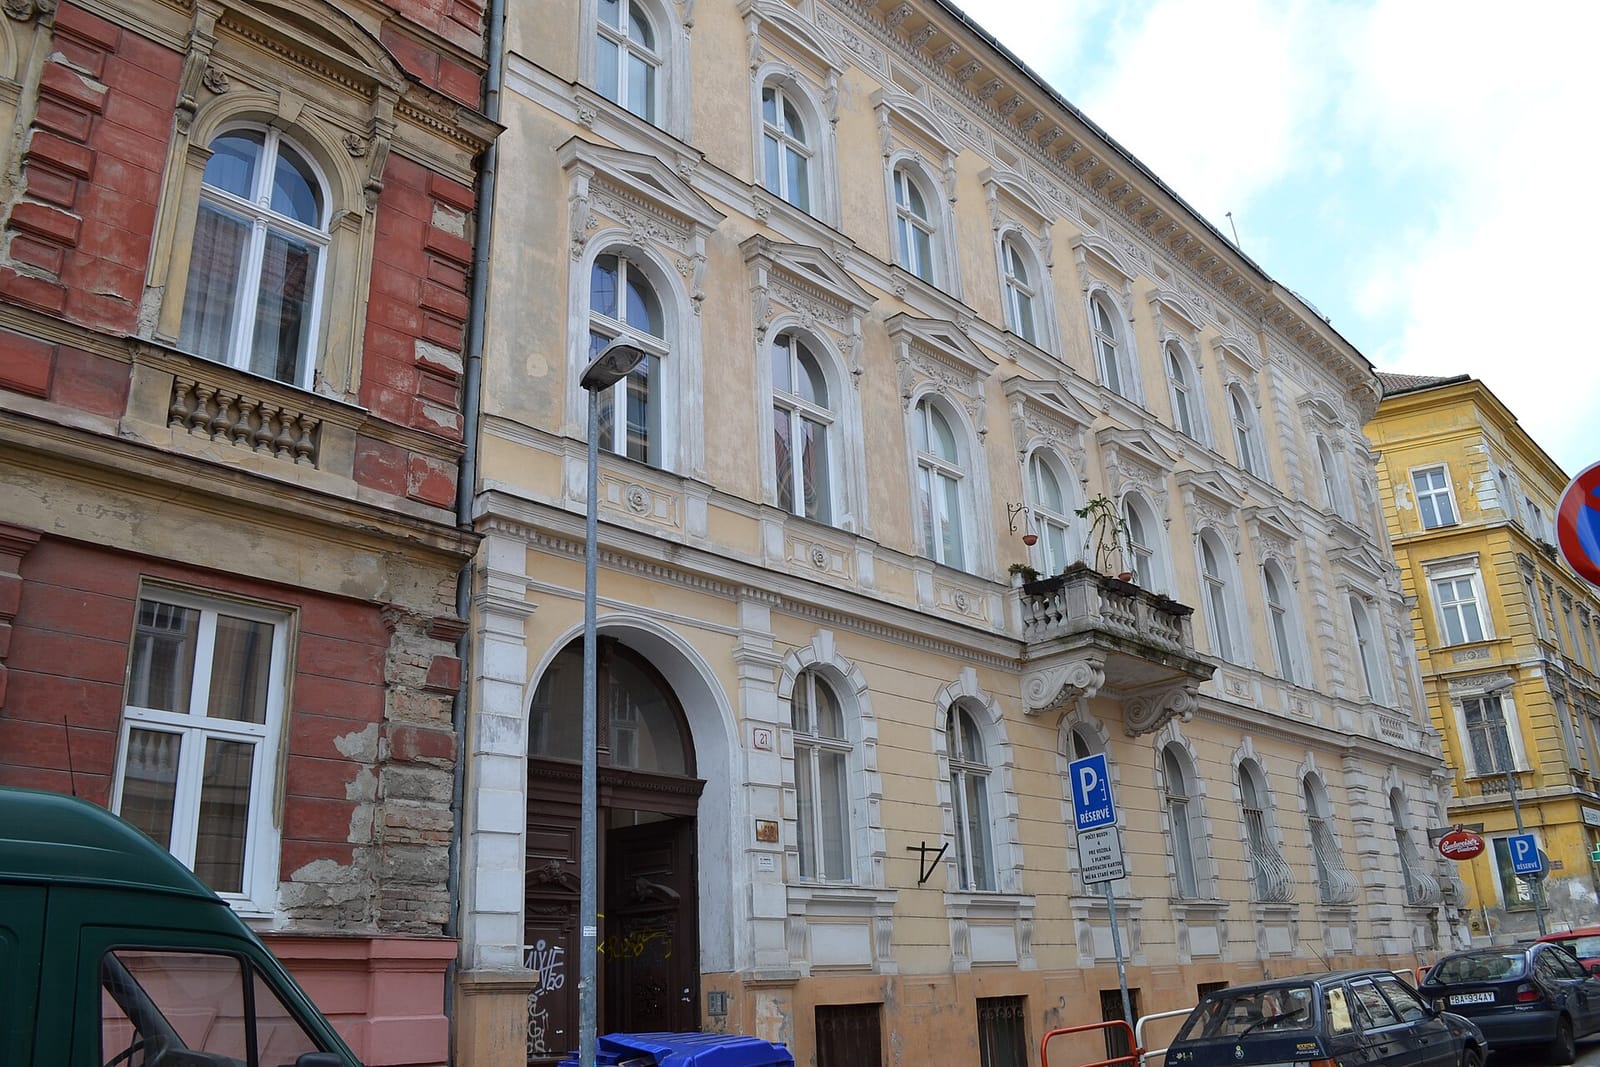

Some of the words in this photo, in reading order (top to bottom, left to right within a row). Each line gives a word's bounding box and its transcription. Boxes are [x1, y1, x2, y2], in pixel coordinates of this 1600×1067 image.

[759, 732, 768, 745] 21
[1080, 766, 1098, 806] P
[1080, 805, 1110, 824] RÉSERVÉ
[1096, 846, 1111, 854] VOZIDLÁ
[1515, 839, 1529, 861] P
[1083, 863, 1107, 871] PARKOVACOU
[1516, 861, 1539, 871] RÉSERVÉ
[1109, 868, 1122, 876] MESTO
